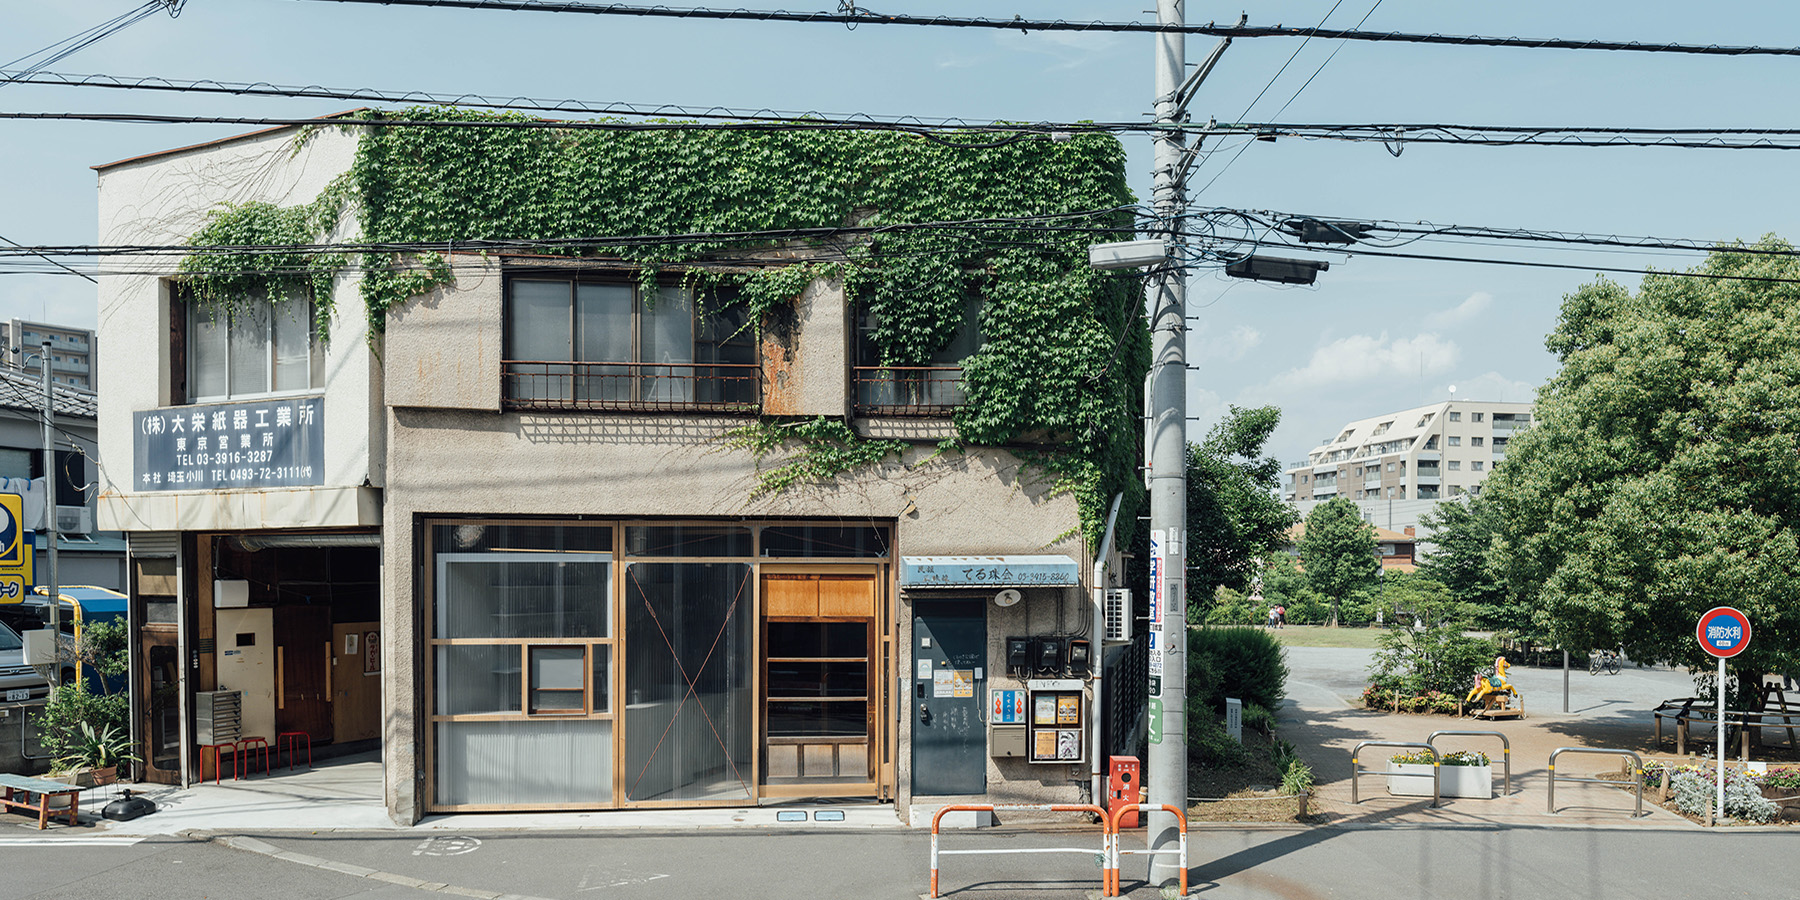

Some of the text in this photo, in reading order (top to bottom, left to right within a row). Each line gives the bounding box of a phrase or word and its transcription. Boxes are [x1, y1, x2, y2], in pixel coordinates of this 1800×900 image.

[142, 405, 314, 435] (株)大栄紙器工業所
[176, 432, 273, 452] 東京営業所
[177, 450, 273, 466] TEL 03-3916-3287
[142, 472, 161, 484] 本社
[167, 470, 204, 483] 埼玉小川
[212, 469, 227, 481] TEL
[1707, 626, 1741, 639] 消防水利
